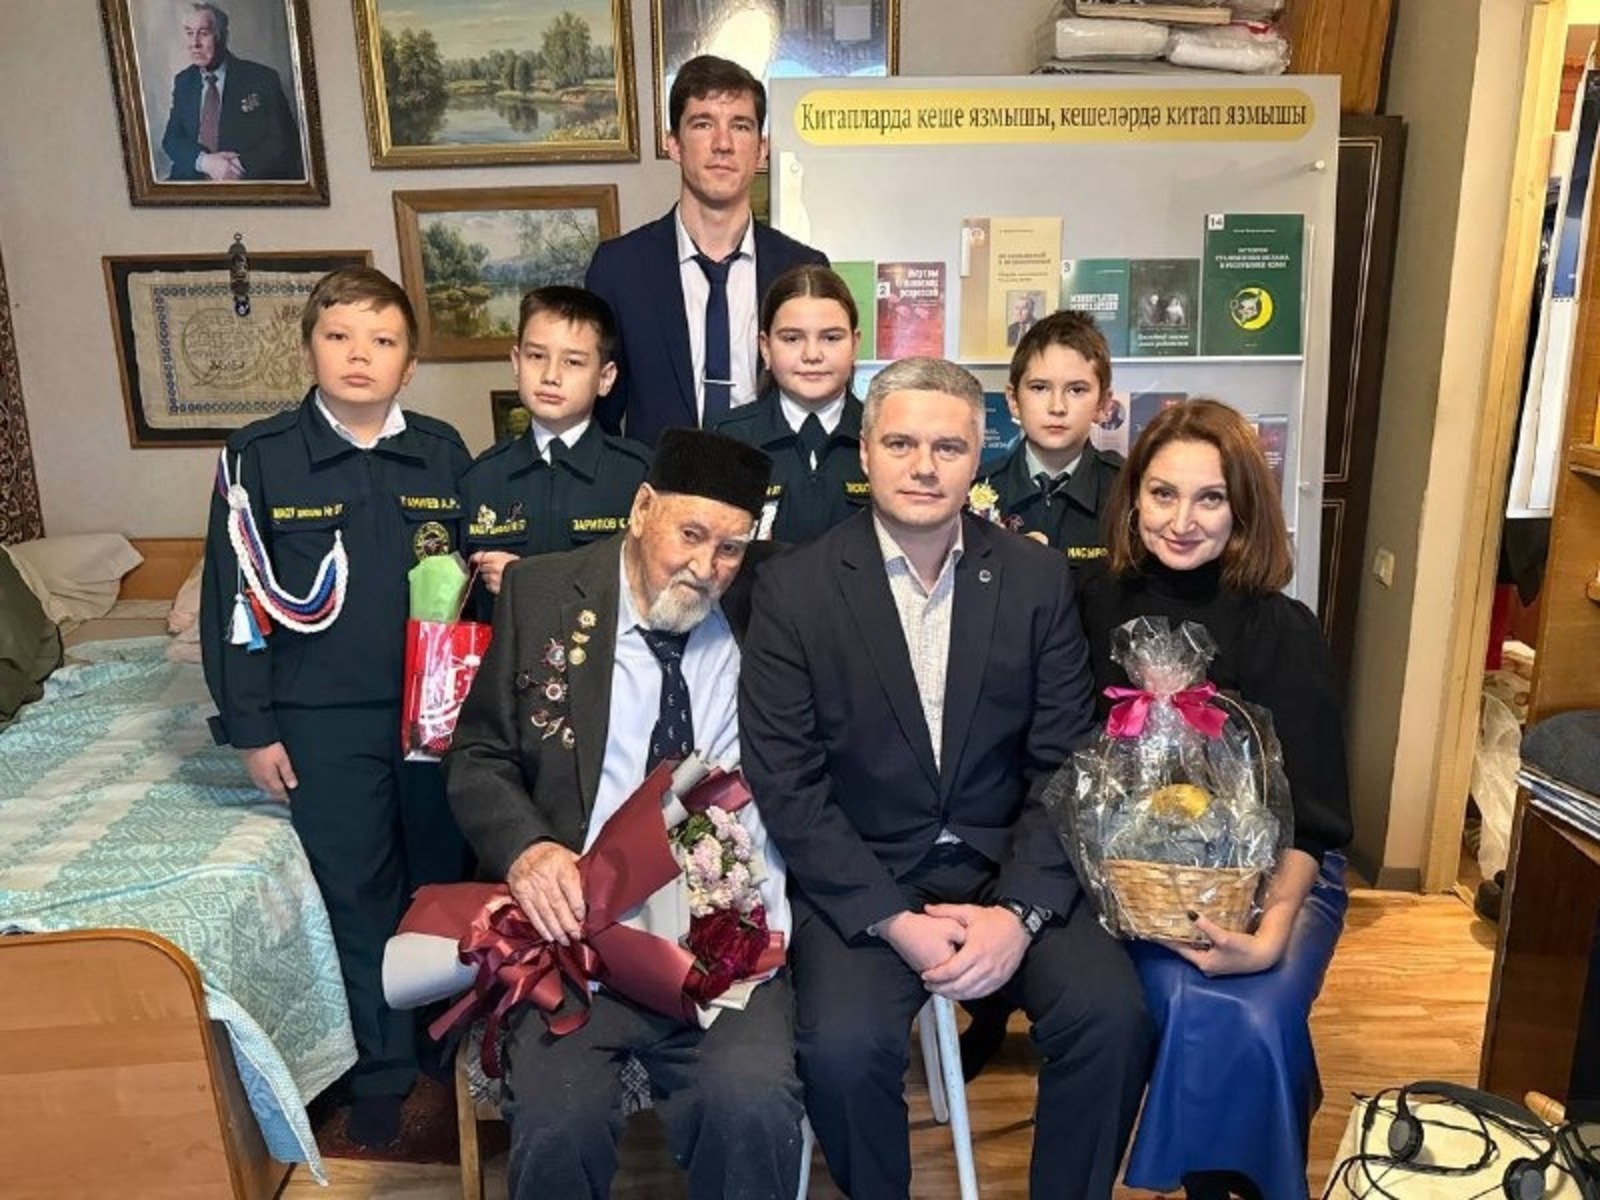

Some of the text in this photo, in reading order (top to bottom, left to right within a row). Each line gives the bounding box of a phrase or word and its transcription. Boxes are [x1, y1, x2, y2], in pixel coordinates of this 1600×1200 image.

[802, 103, 1307, 135] Китапларда кеше язмышы, кешеләрдә китап язмышы
[1210, 217, 1223, 227] 14
[1063, 261, 1071, 272] 3
[880, 285, 887, 295] 2
